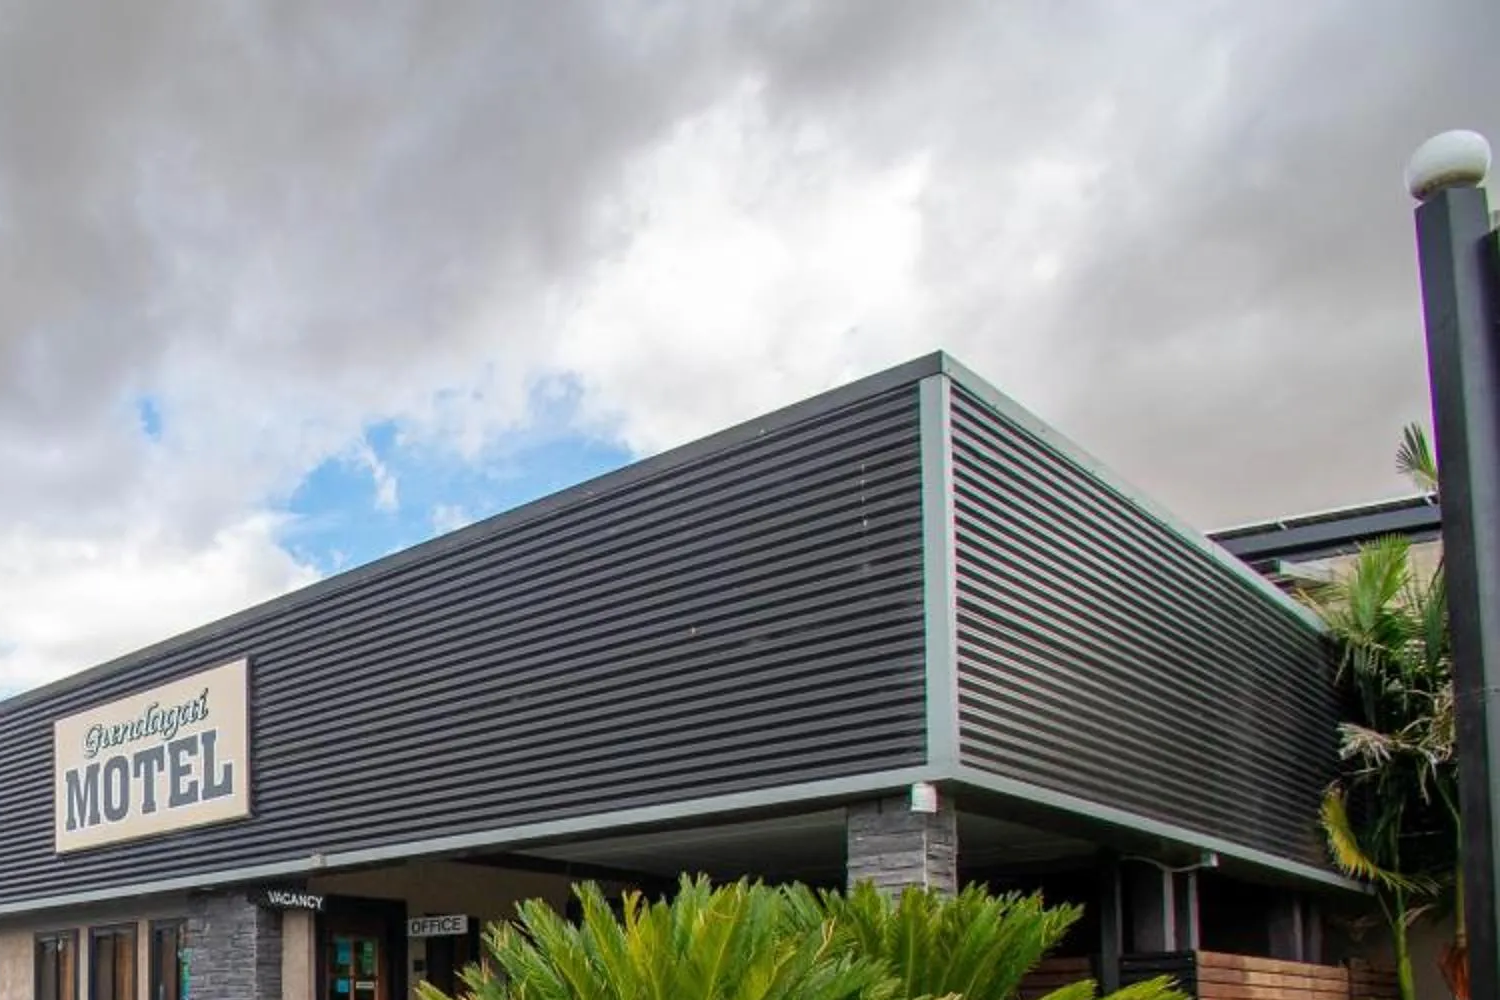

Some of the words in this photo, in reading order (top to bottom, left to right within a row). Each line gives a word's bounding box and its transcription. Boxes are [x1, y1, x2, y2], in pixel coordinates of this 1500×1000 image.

[83, 687, 209, 759] Gundagai
[65, 729, 234, 832] MOTEL
[267, 890, 323, 909] VACANCY
[411, 917, 463, 935] OFFICE
